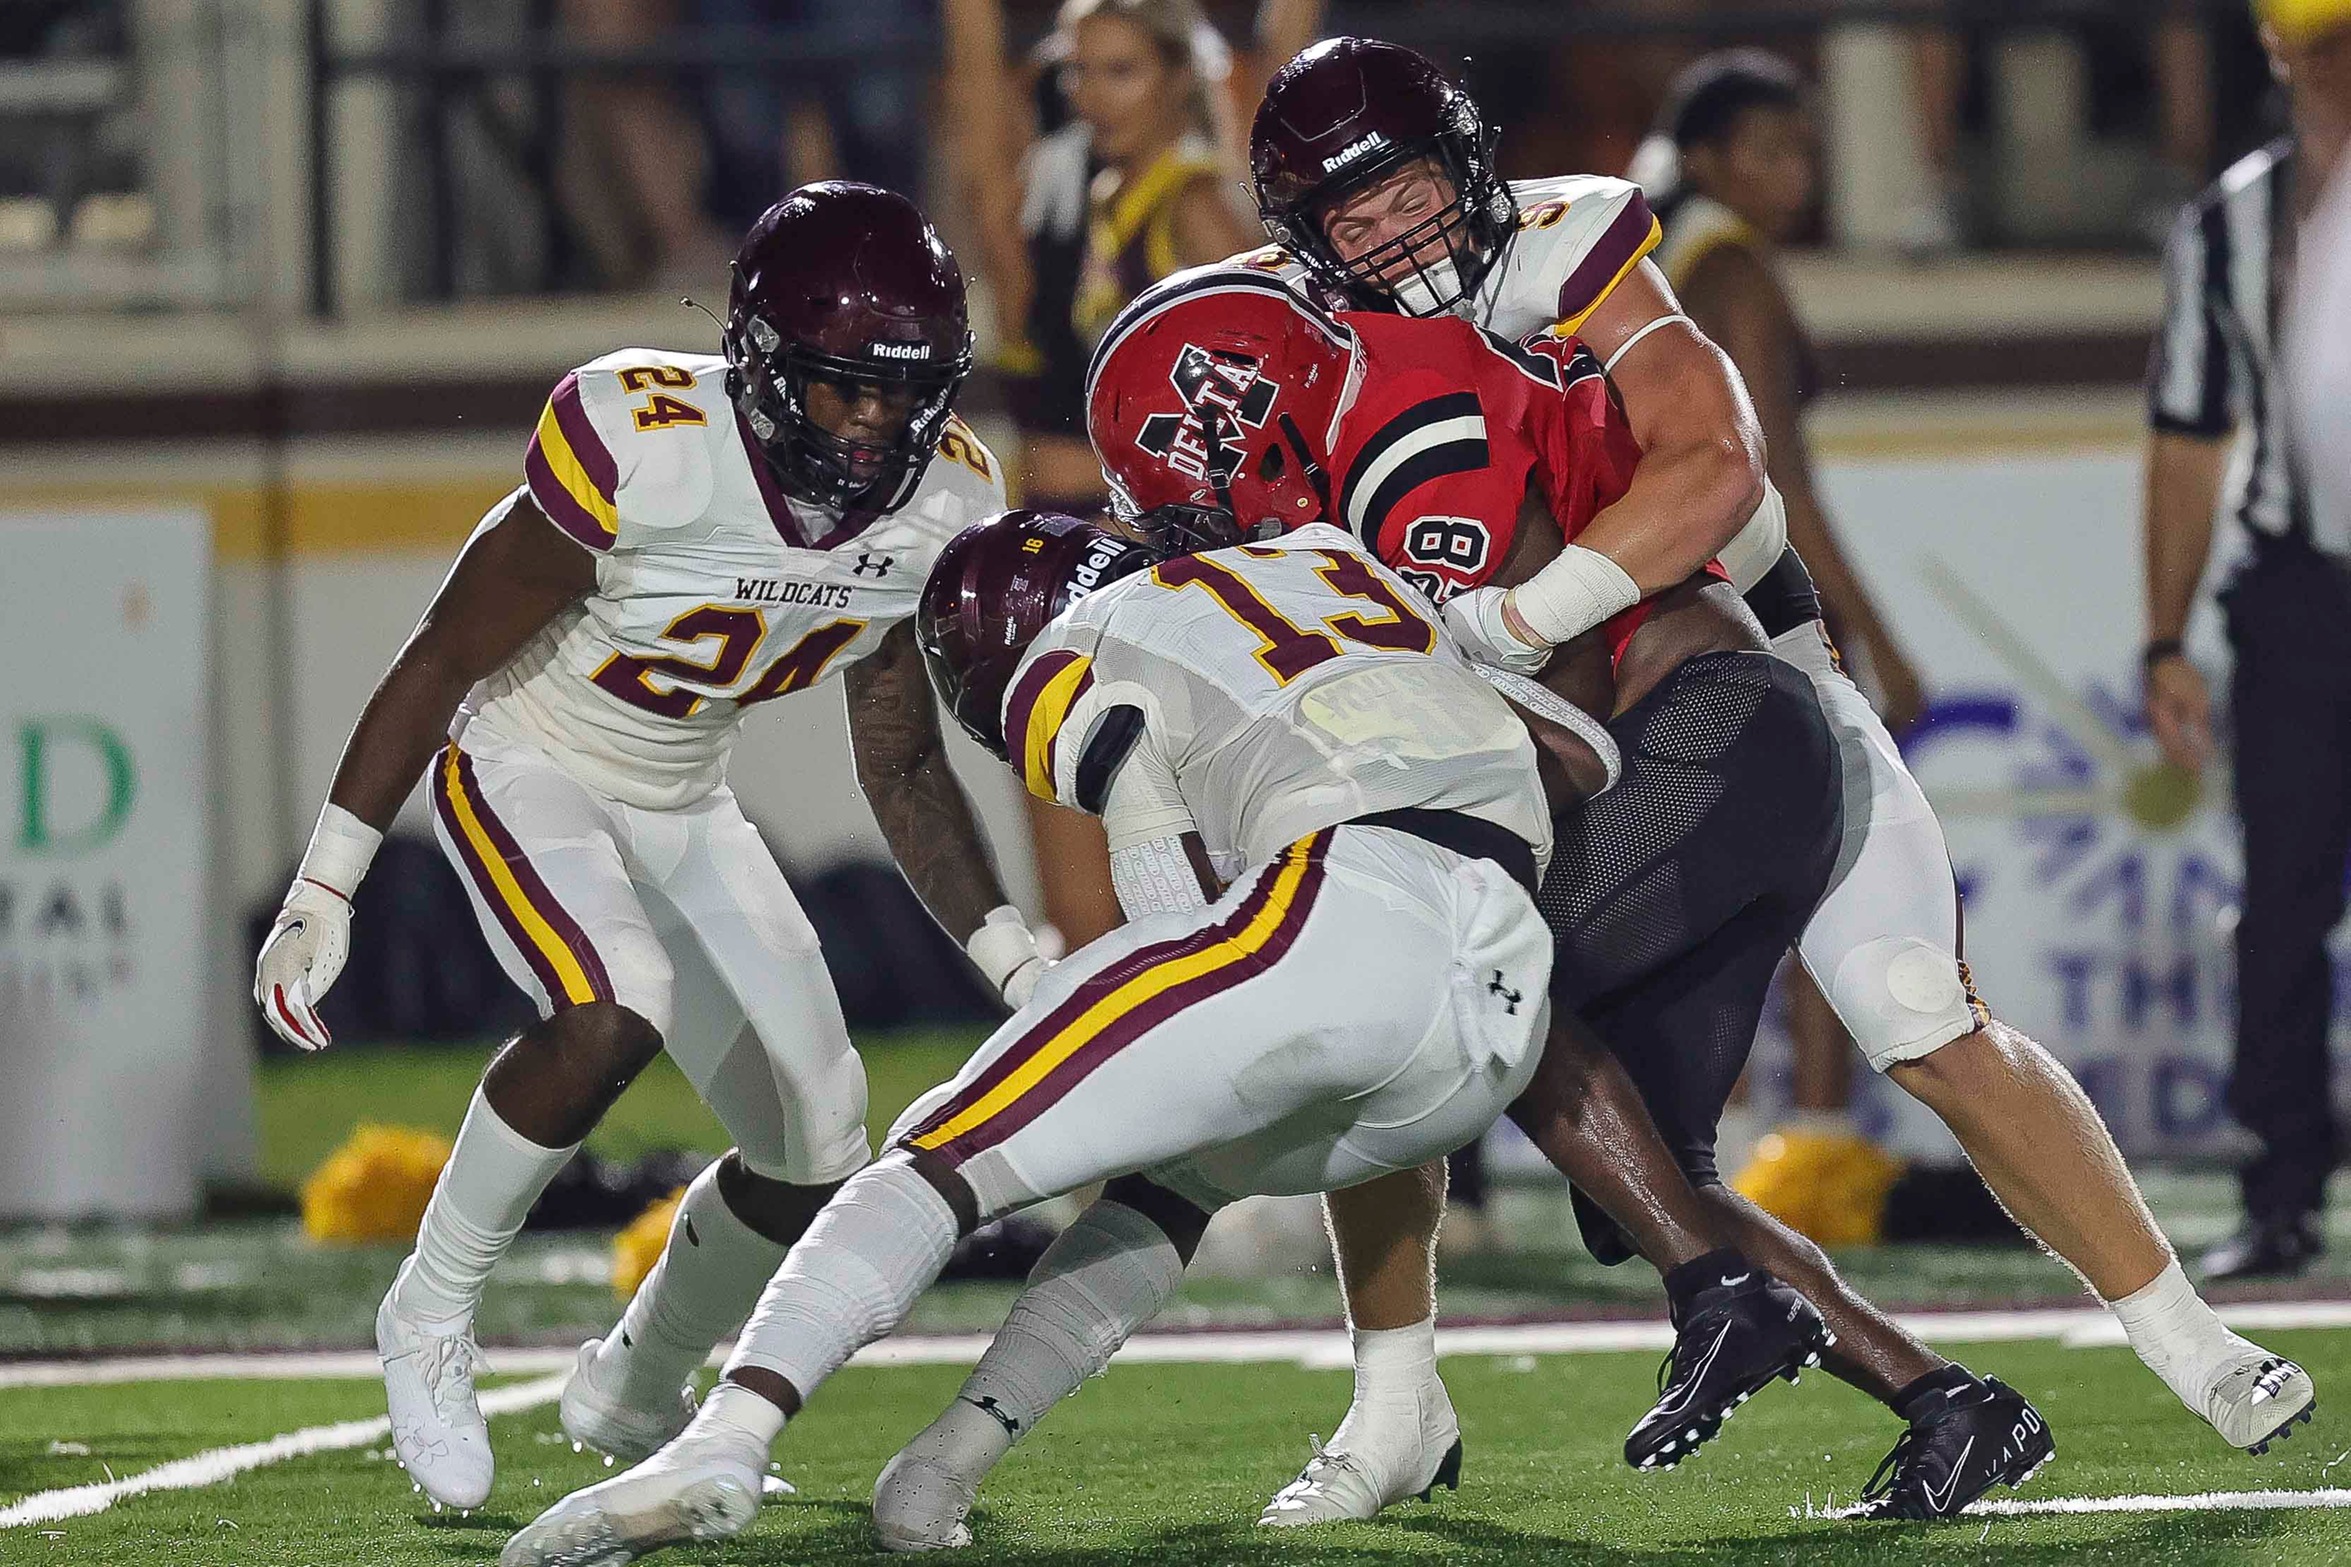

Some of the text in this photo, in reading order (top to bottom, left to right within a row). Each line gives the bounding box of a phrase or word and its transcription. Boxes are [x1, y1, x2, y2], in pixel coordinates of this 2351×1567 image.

[1321, 130, 1382, 175] Riddell
[872, 343, 931, 360] Riddell
[614, 365, 708, 432] 24
[735, 577, 853, 609] WILDCATS
[1064, 537, 1128, 608] ddell
[1150, 546, 1437, 688] 13
[588, 602, 870, 719] 24
[1985, 1406, 2041, 1477] VAPO
